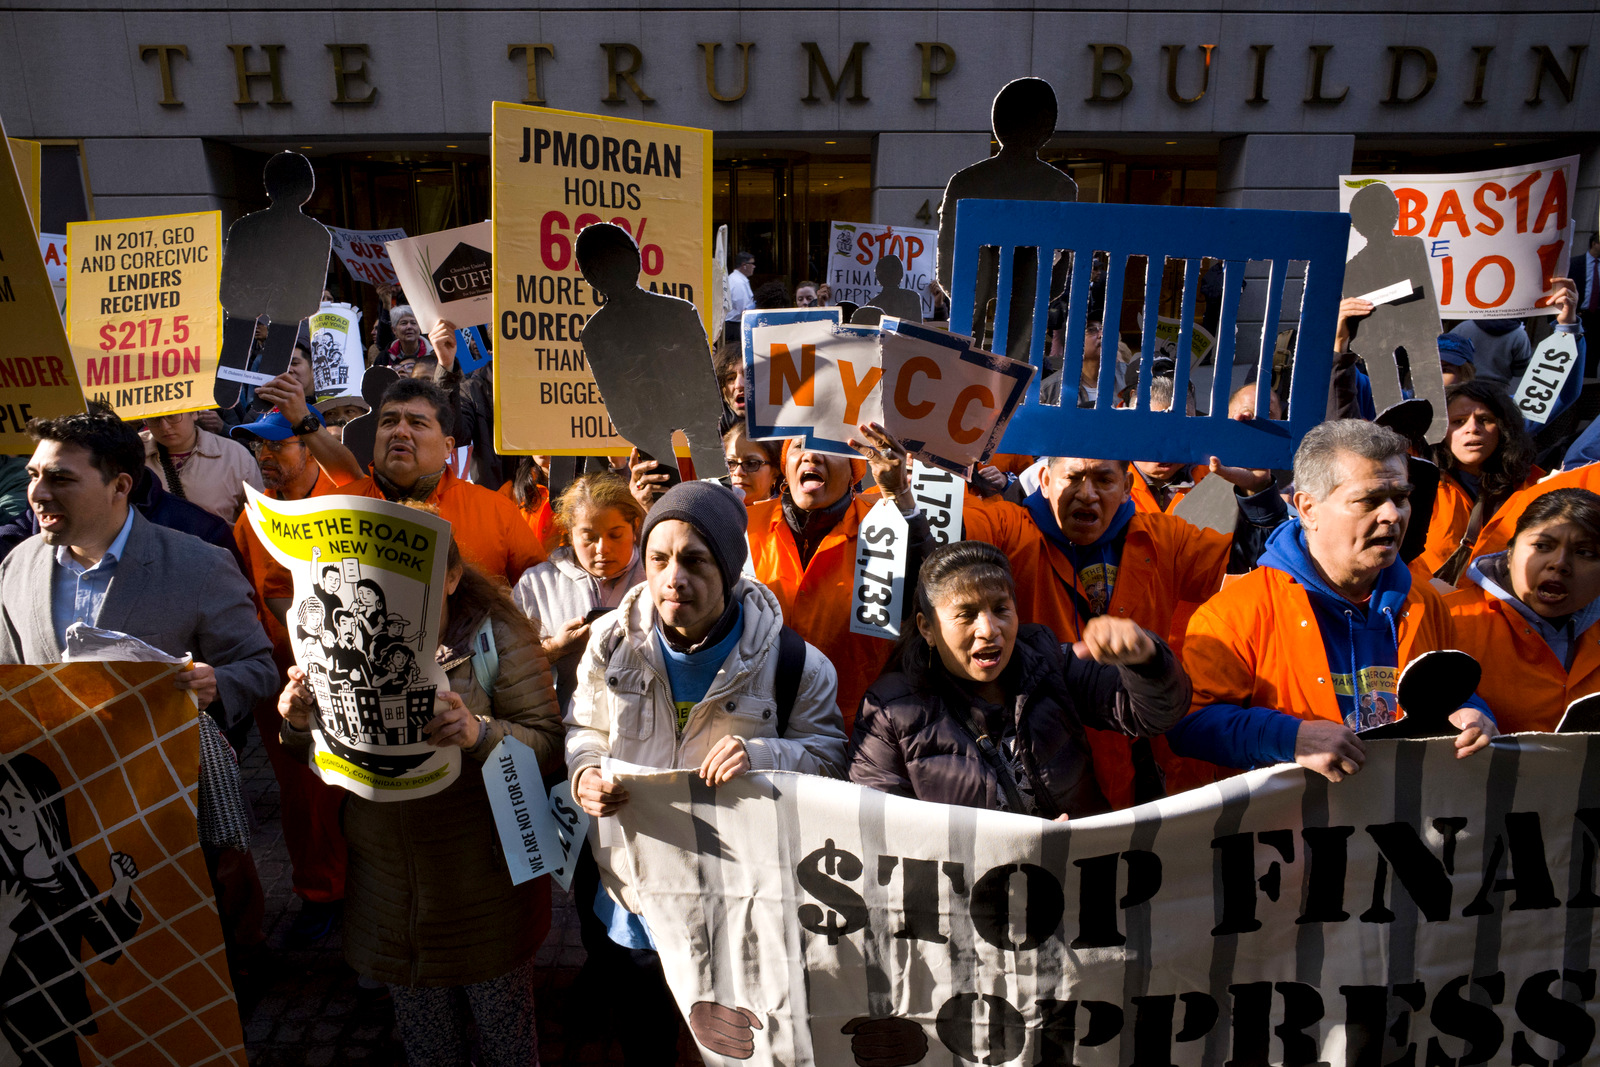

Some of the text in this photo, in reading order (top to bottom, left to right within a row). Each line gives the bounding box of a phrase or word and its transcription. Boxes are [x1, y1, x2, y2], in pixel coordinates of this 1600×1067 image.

[139, 42, 1588, 106] THE TRUMP BUILDIN
[519, 127, 681, 178] JPMORGAN
[565, 177, 641, 210] HOLDS
[1393, 168, 1568, 237] BASTA
[95, 226, 194, 251] IN 2017, GEO
[350, 241, 388, 259] OUR
[856, 226, 924, 271] STOP
[81, 245, 208, 273] AND CORECIVIC
[346, 258, 397, 284] PAIN
[109, 269, 182, 292] LENDERS
[440, 268, 492, 293] CUFF
[517, 275, 585, 305] MORE
[835, 269, 929, 291] FINANG
[101, 291, 180, 314] RECEIVED
[99, 315, 190, 352] $217.5
[324, 315, 348, 326] ROAD
[330, 321, 347, 331] YORK
[1157, 324, 1173, 333] AKE
[0, 356, 69, 388] NDER
[86, 345, 200, 387] MILLION
[534, 348, 585, 371] THAN
[94, 380, 193, 408] IN INTEREST
[768, 343, 995, 445] NYCC
[1519, 348, 1572, 414] $1,733
[913, 462, 954, 550] 1,73
[271, 517, 429, 552] MAKE THE ROAD
[328, 540, 425, 572] NEW YORK
[856, 525, 899, 628] $1,733
[1380, 680, 1397, 689] YOR
[321, 757, 352, 775] DIGNIDAD,
[353, 769, 402, 787] COMUNIDAD
[412, 772, 441, 785] PODER
[499, 754, 544, 874] WE ARE NOT FOR SALE
[936, 968, 1597, 1067] OPPRESS
